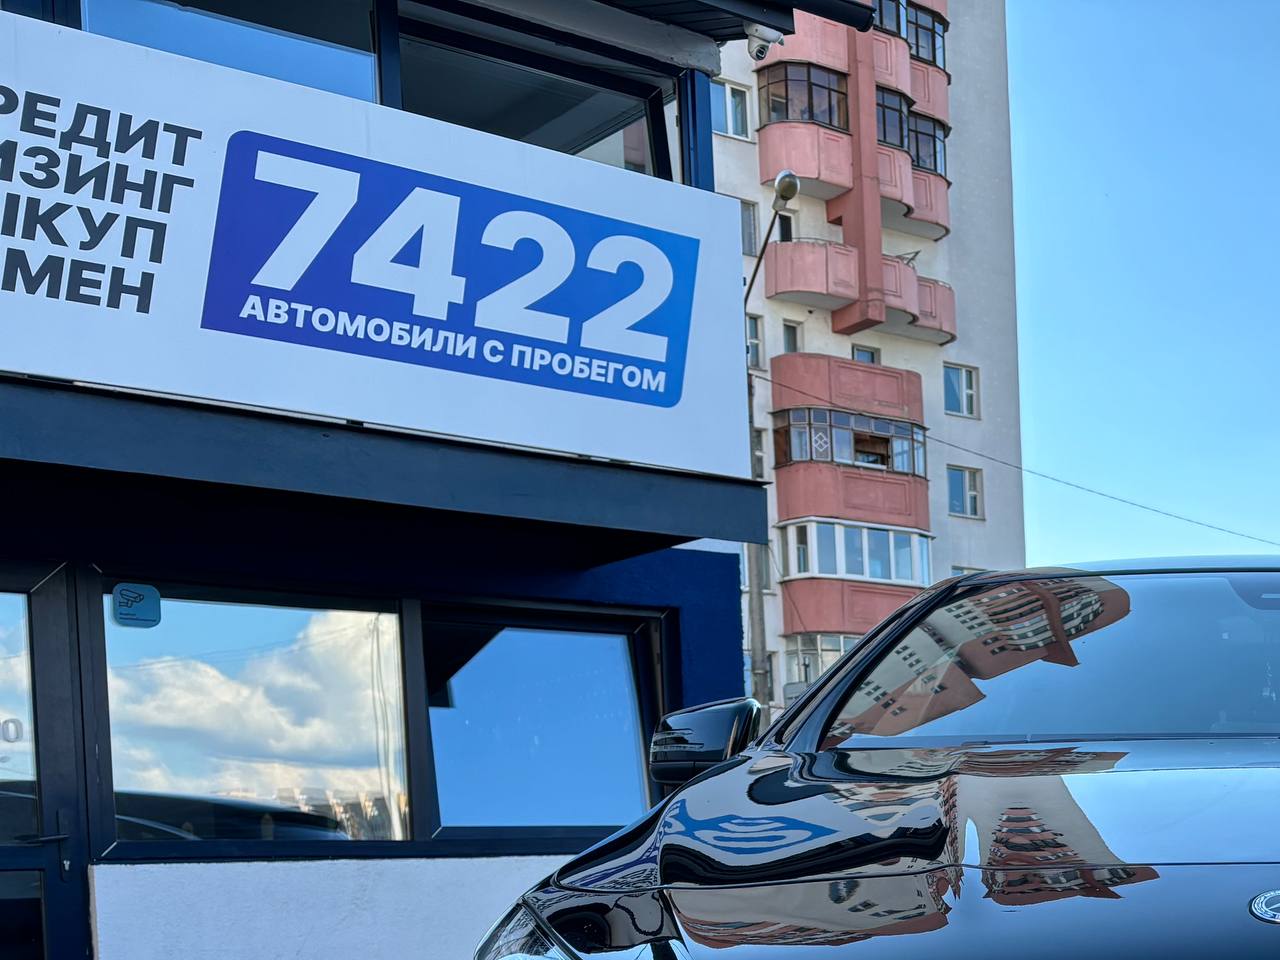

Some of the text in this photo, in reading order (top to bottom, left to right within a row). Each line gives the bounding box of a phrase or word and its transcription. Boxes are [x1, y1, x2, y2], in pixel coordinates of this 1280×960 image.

[250, 150, 675, 363] 7422
[239, 294, 668, 393] АВТОМОБИЛИ С ПРОБЕГОМ
